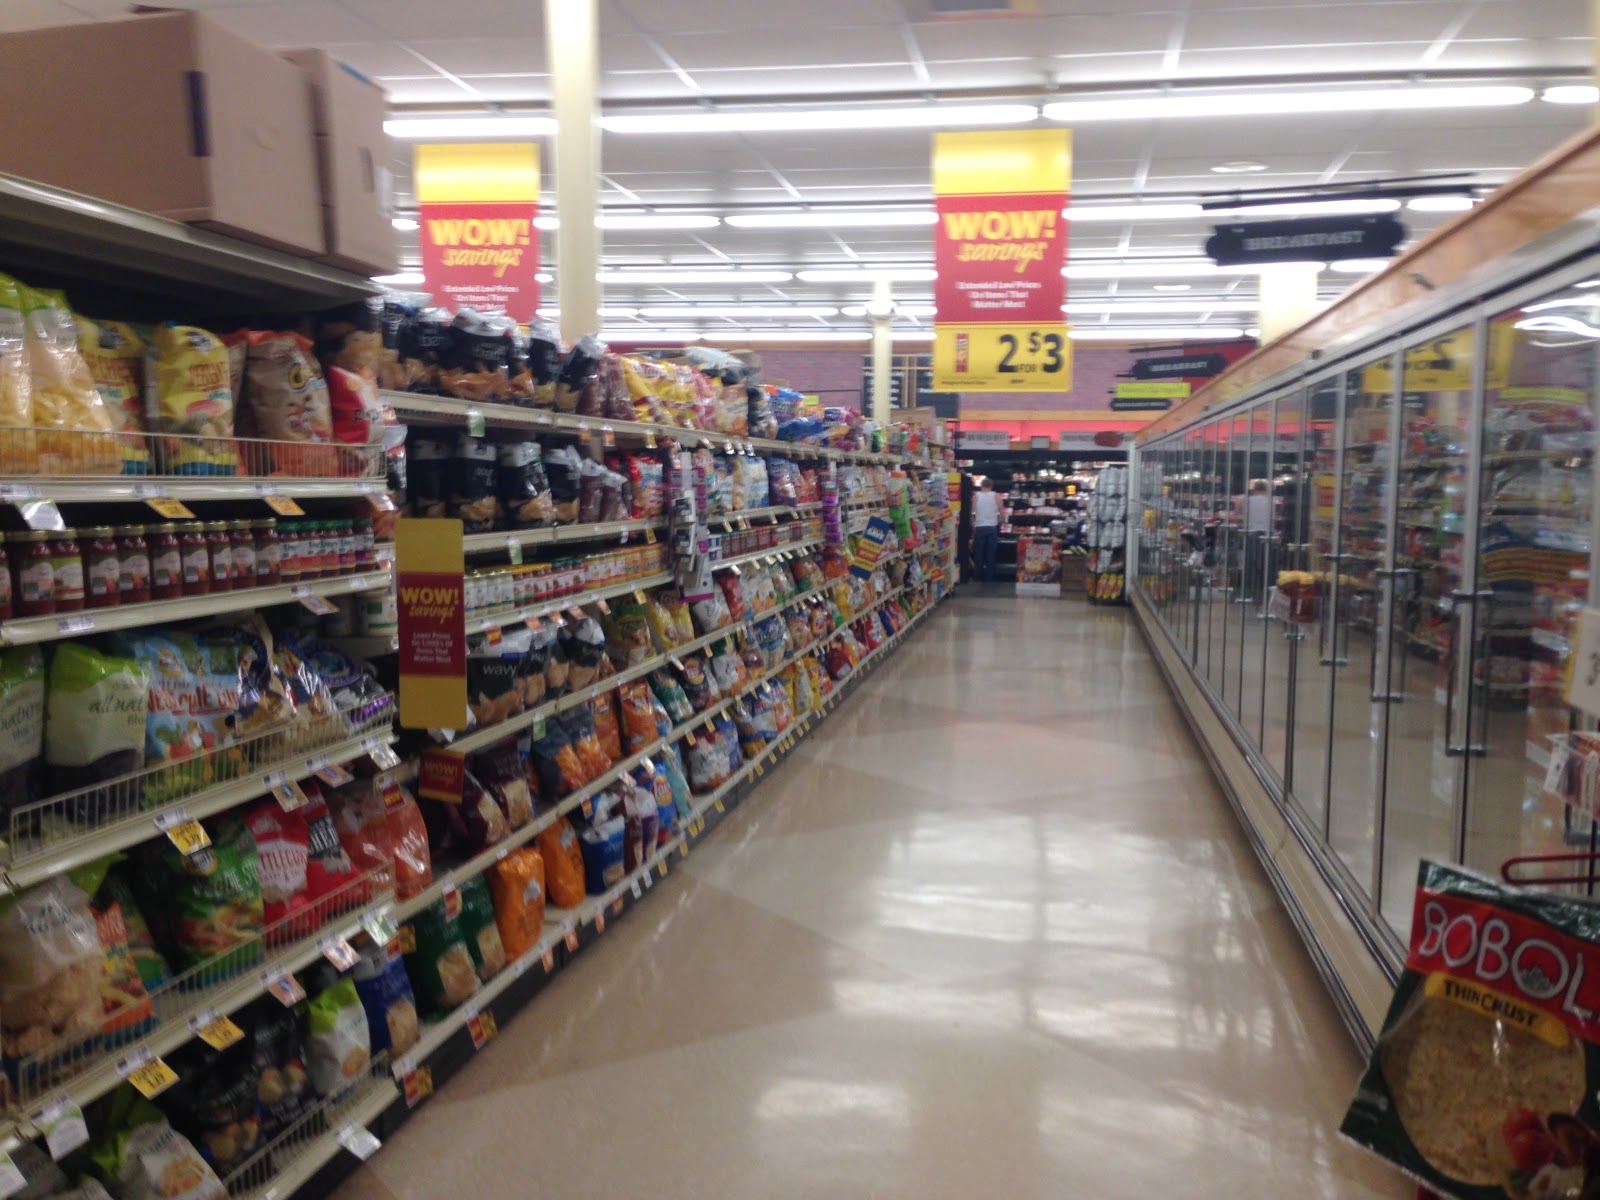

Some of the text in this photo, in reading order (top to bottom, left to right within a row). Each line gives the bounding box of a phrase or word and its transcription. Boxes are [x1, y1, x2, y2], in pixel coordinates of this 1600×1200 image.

[428, 219, 530, 246] WOW!
[944, 211, 1057, 240] WOW!
[1243, 230, 1365, 251] BREAKFAST
[441, 249, 523, 277] savings
[957, 242, 1048, 273] savings
[998, 333, 1019, 374] 2
[401, 586, 460, 606] WOW!
[410, 605, 455, 624] savings
[483, 664, 517, 678] wavy
[425, 762, 458, 776] WOW!
[1419, 902, 1600, 1024] BOBOL
